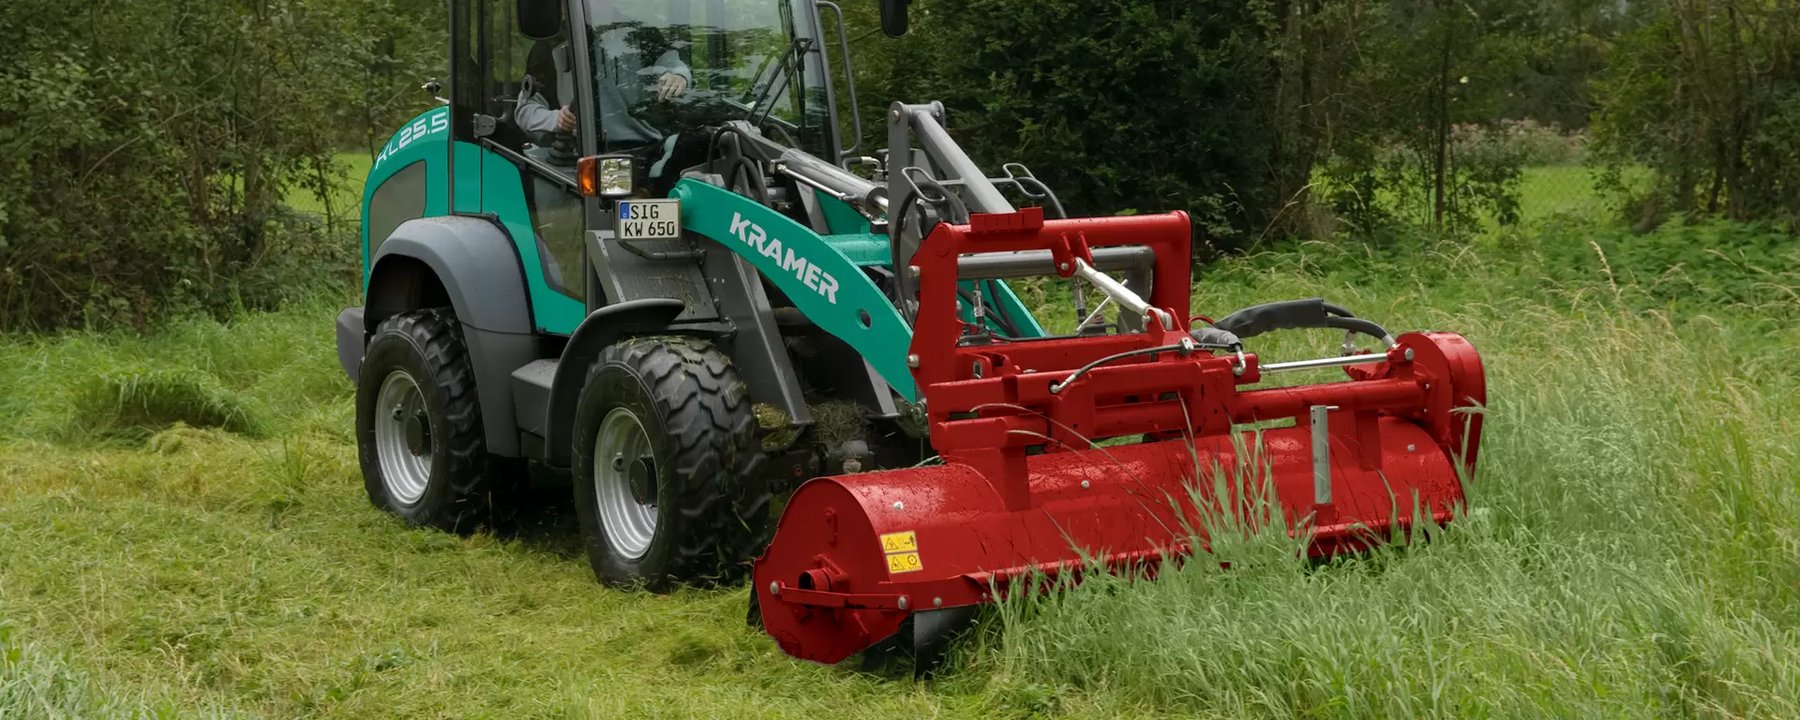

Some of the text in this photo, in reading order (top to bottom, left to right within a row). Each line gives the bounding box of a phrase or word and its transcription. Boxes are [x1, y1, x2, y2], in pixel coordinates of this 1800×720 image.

[375, 112, 448, 170] KL25.5
[624, 221, 675, 237] KW 650
[631, 204, 659, 219] SIG
[729, 211, 839, 304] KRAMER
